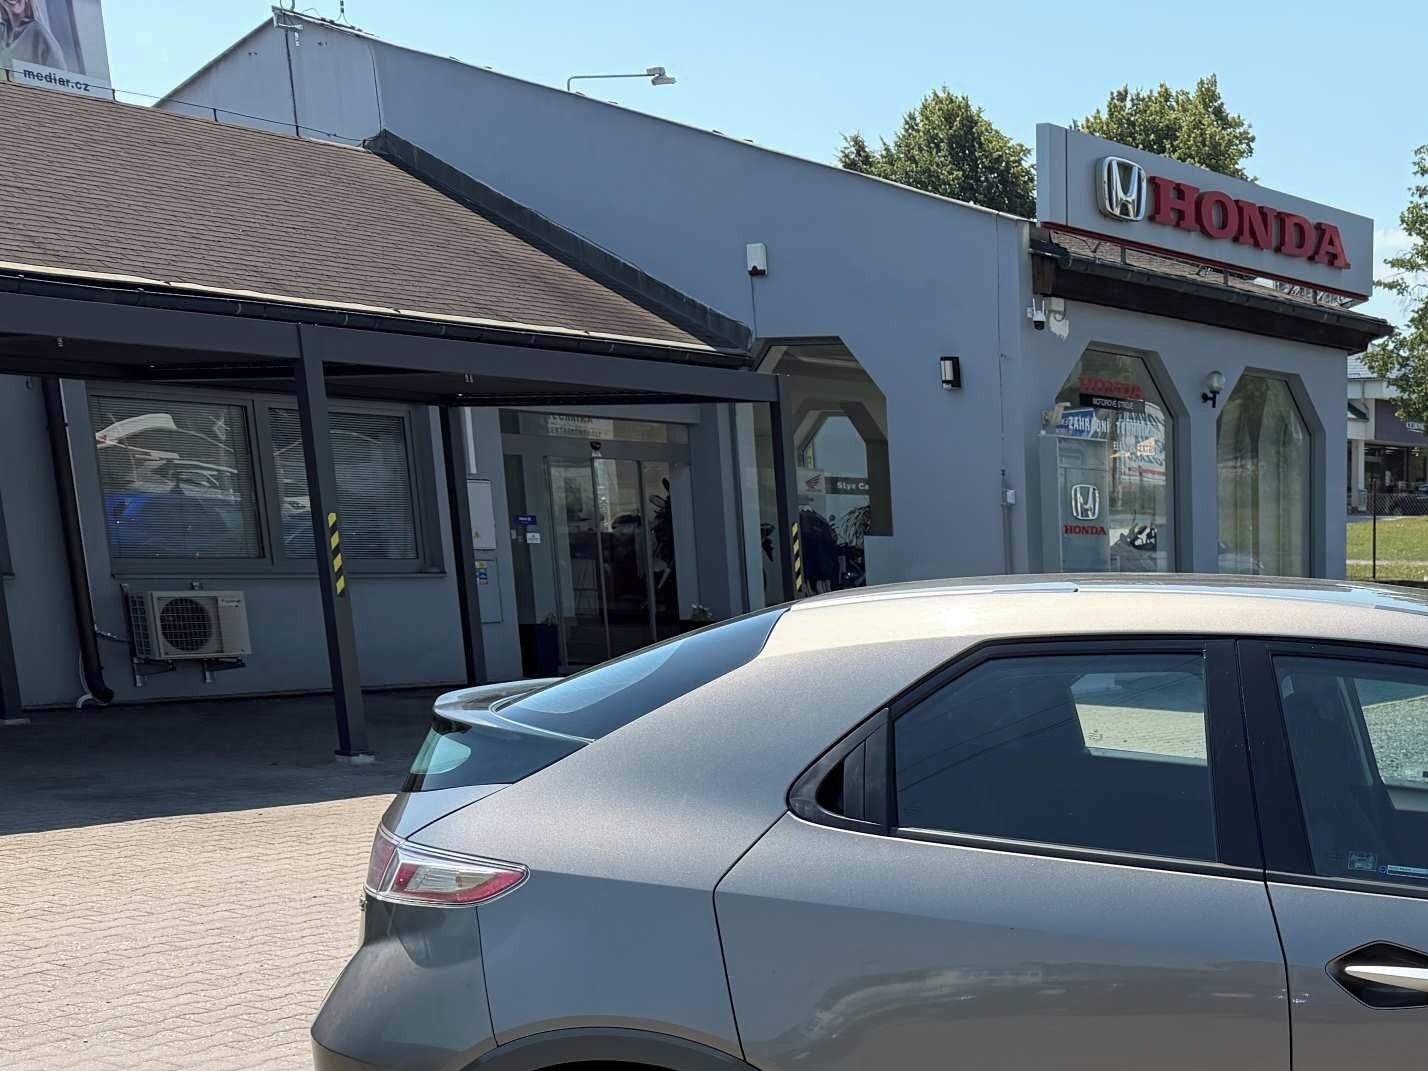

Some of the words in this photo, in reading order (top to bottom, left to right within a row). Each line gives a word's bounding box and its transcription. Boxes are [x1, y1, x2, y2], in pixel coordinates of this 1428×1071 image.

[23, 69, 90, 92] mediar.cz
[1150, 176, 1351, 269] HONDA
[1064, 525, 1106, 535] HONDA
